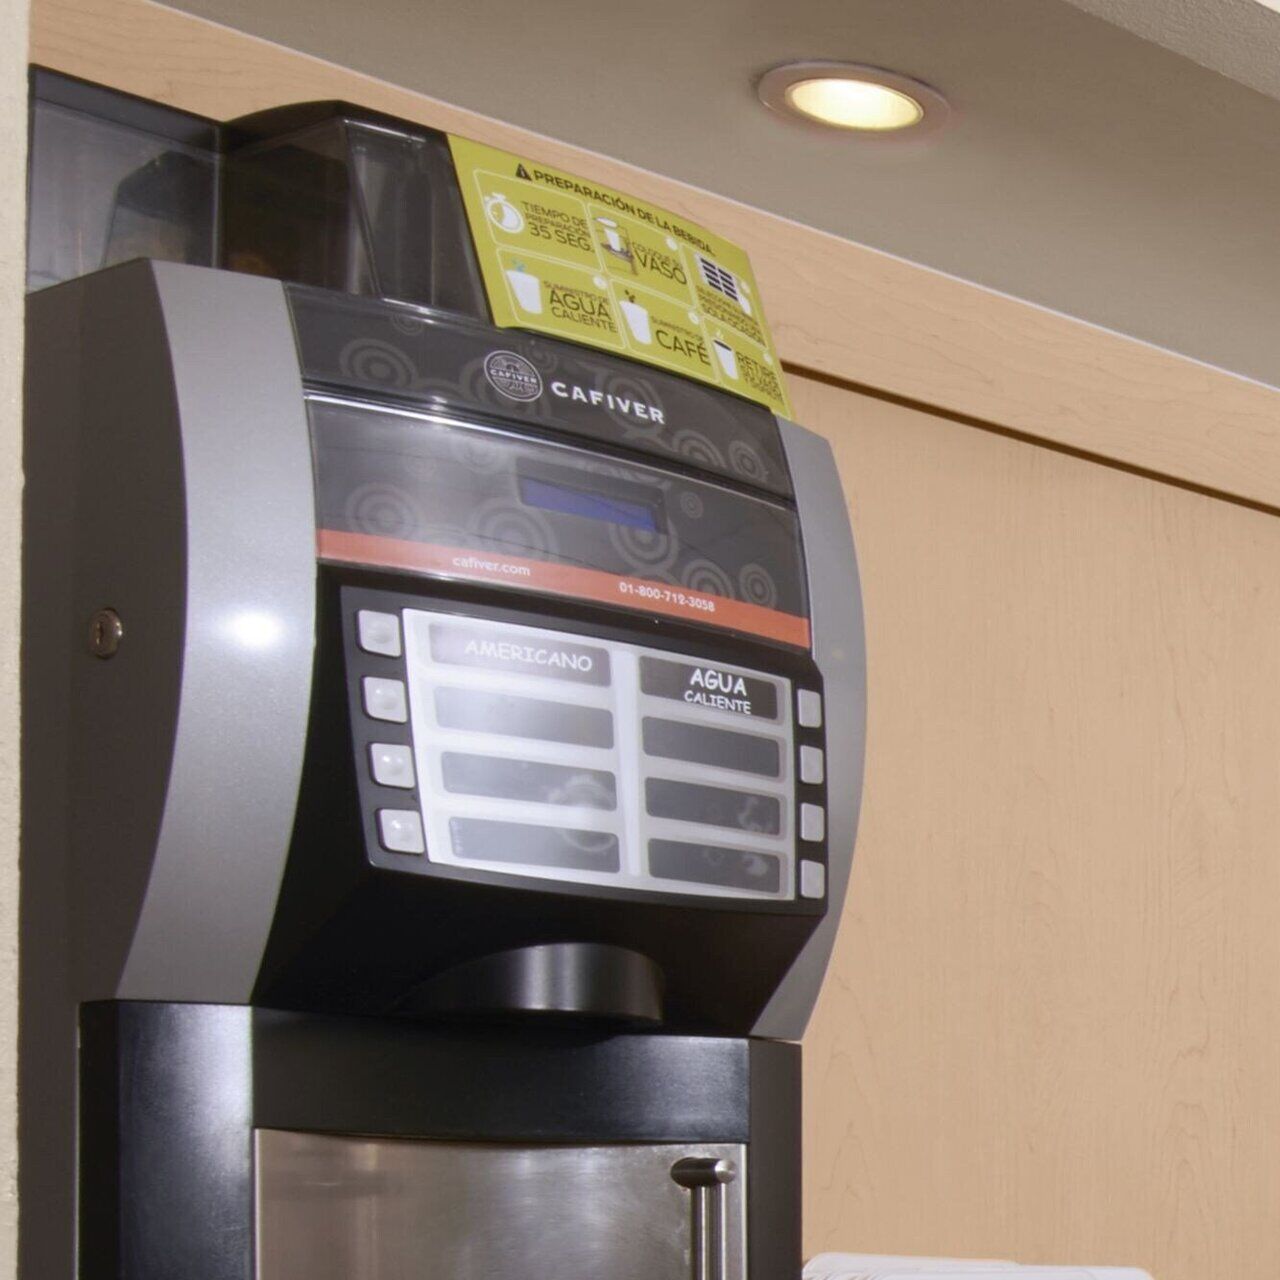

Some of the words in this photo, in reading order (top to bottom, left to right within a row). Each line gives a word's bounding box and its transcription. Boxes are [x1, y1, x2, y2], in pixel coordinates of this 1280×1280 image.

[520, 200, 570, 224] TIEMPO
[571, 215, 589, 230] DE
[533, 169, 636, 216] PREPARACIÓN
[637, 208, 655, 225] DE
[656, 216, 671, 234] LA
[528, 221, 552, 241] 35
[554, 228, 596, 254] SEG.
[633, 248, 688, 285] VASO
[549, 288, 612, 322] AGUA
[551, 305, 619, 334] CALIENTE
[655, 328, 712, 367] CAFÉ
[550, 381, 666, 425] CAFIVER
[452, 555, 531, 577] cafiver.com
[464, 638, 594, 673] AMERICANO
[689, 667, 748, 697] AGUA
[683, 689, 751, 716] CALIENTE
